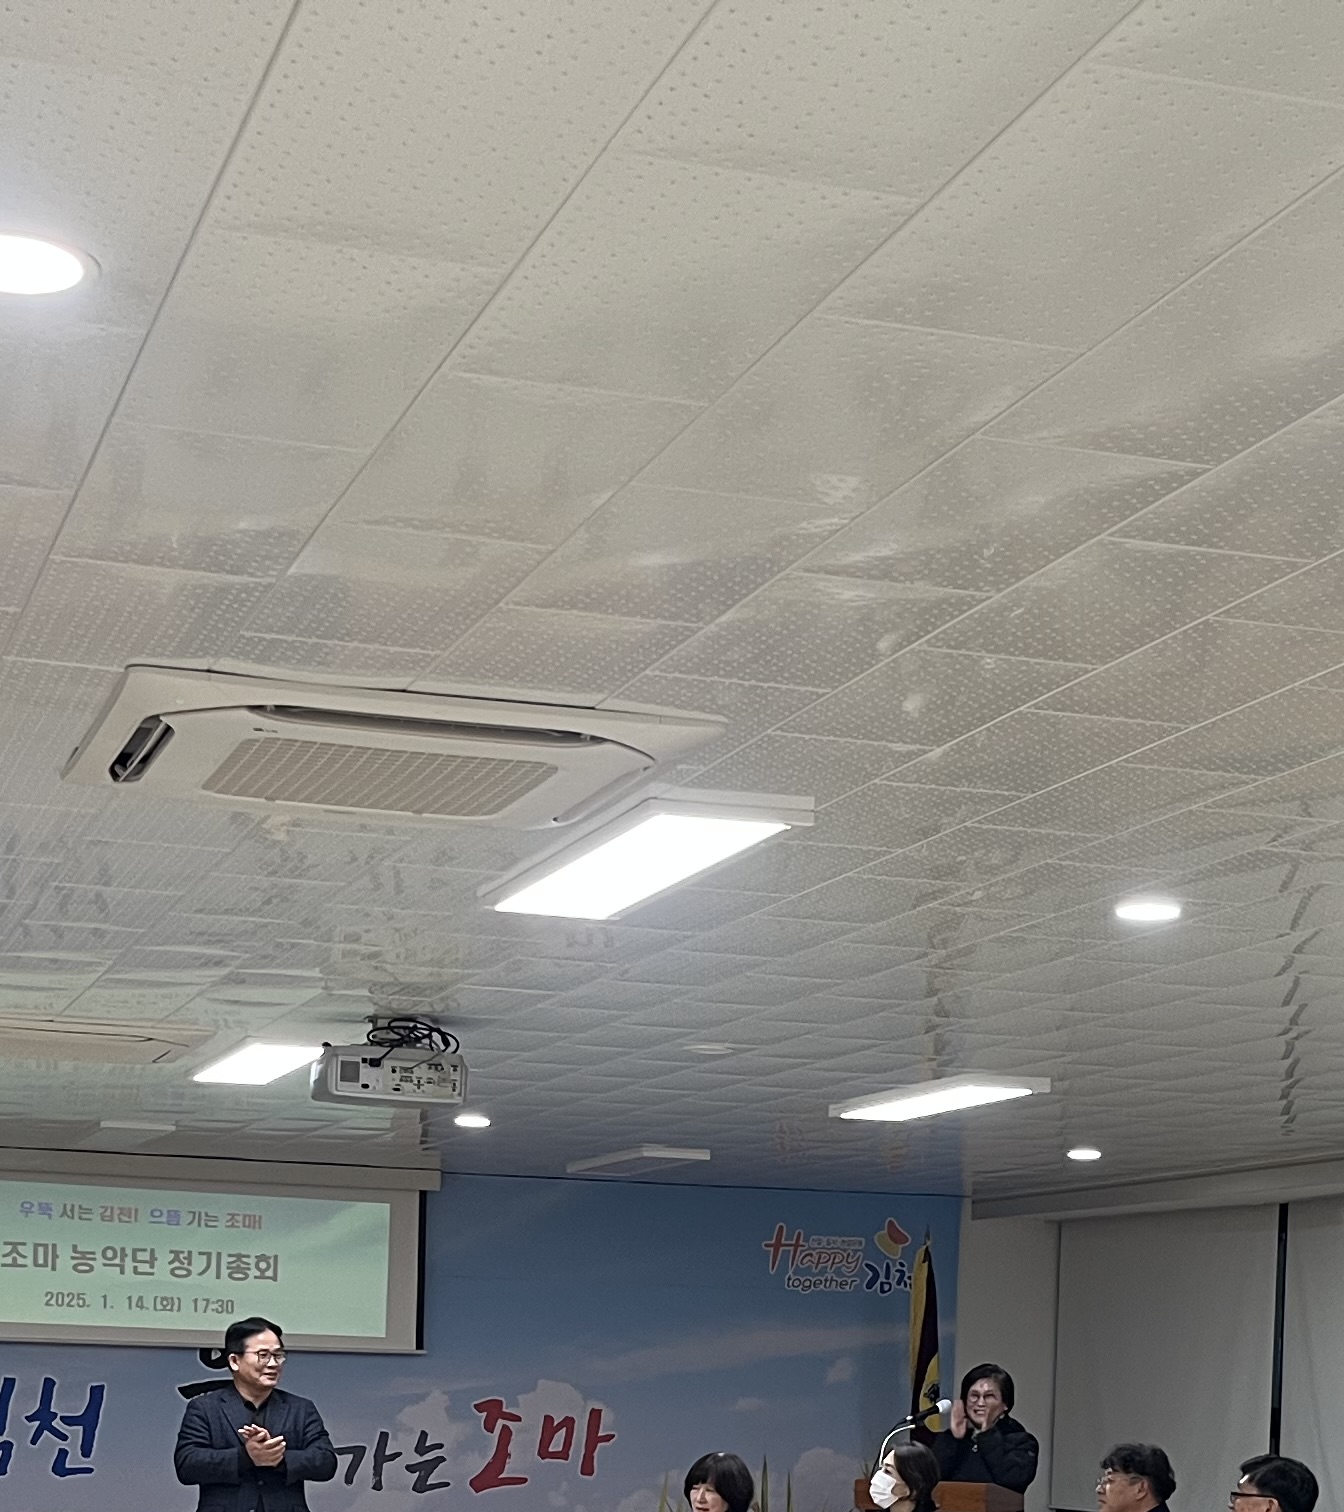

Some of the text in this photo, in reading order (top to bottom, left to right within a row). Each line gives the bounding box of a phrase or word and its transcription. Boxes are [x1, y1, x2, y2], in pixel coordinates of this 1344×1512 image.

[19, 1200, 53, 1219] 우뚝
[58, 1202, 94, 1222] 서는
[148, 1207, 182, 1226] 으뜸
[0, 1240, 280, 1282] 조마 농악단 정기총회
[762, 1223, 863, 1274] Happy
[785, 1274, 858, 1292] together
[44, 1291, 91, 1308] 2025.
[101, 1293, 115, 1309] 1.
[191, 1297, 235, 1315] 17:30
[336, 1429, 452, 1494] 가는
[468, 1398, 616, 1494] 조마
